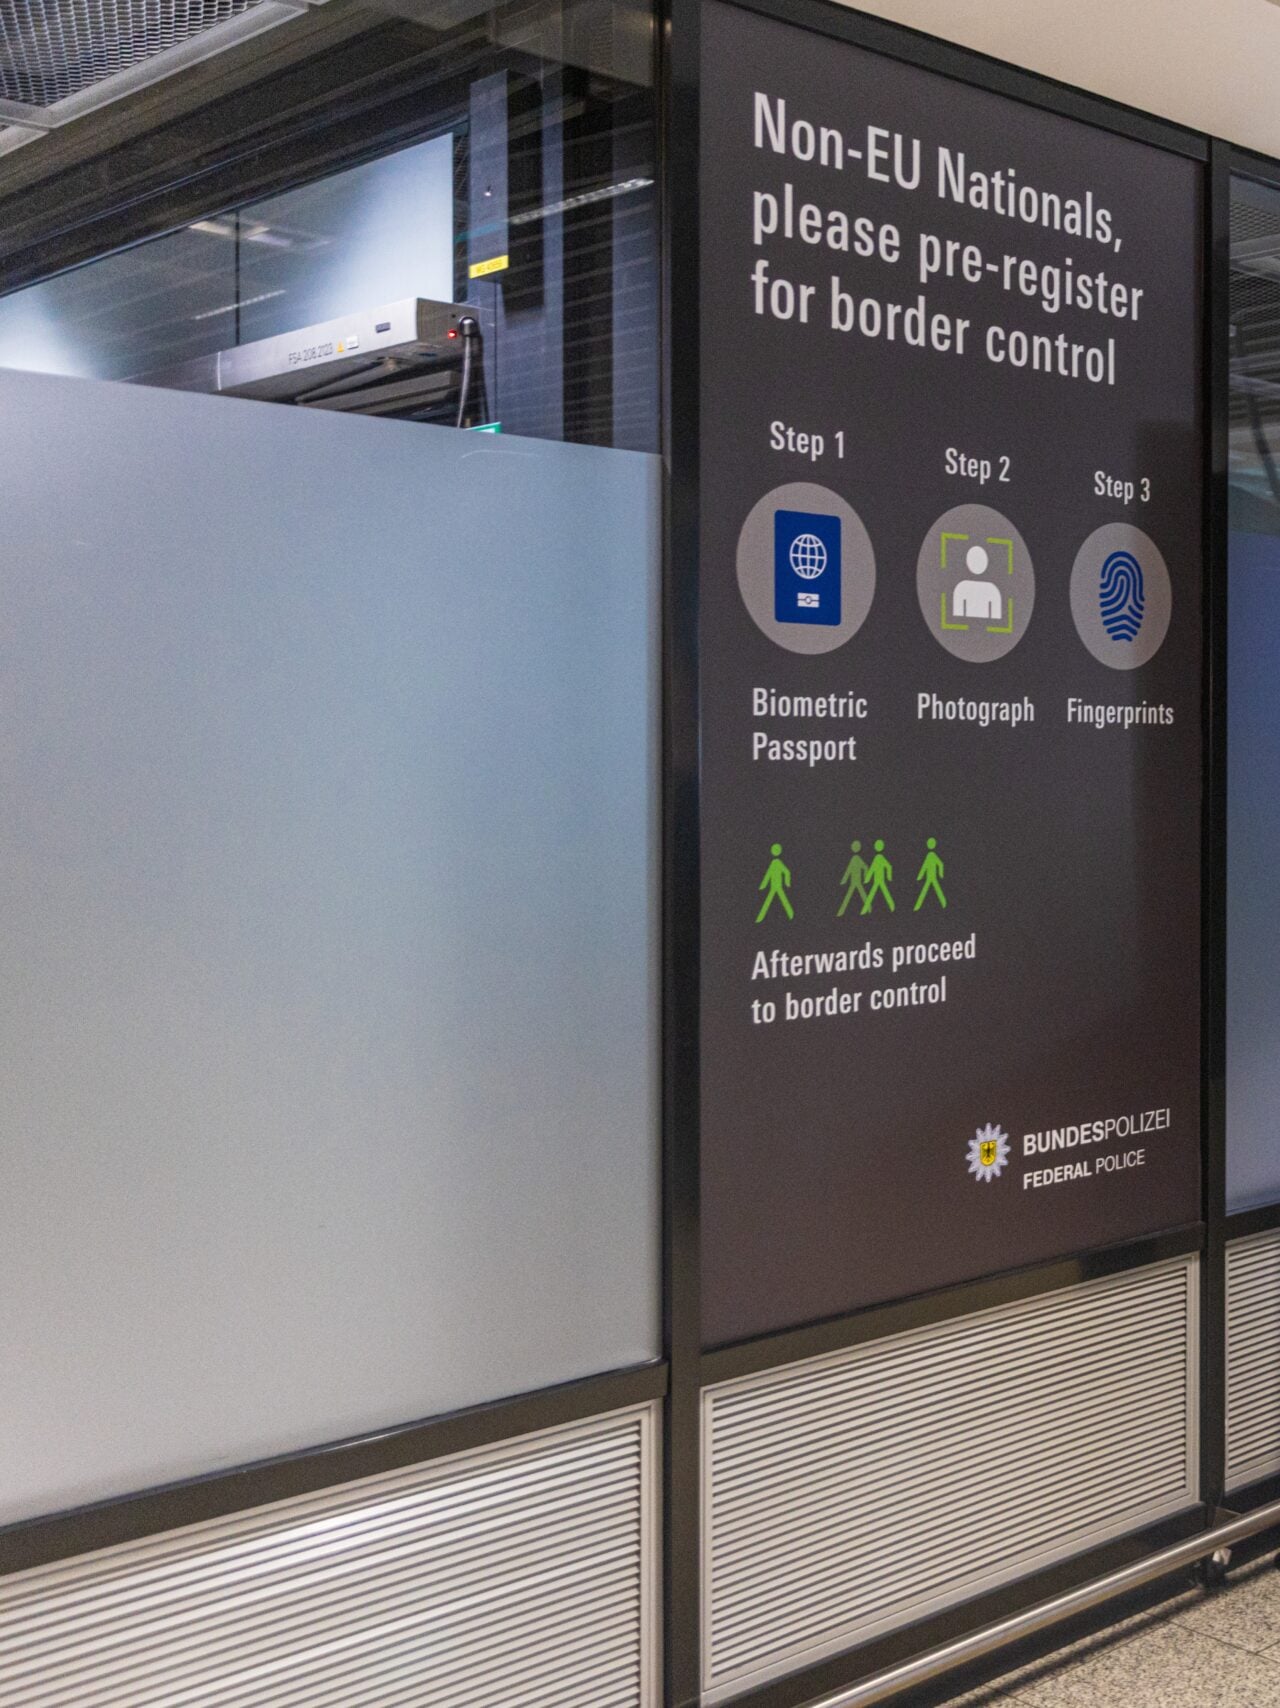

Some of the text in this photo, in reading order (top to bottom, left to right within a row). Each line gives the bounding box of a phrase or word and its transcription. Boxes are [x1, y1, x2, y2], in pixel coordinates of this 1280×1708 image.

[754, 91, 1122, 253] Non-EU Nationals,
[753, 183, 1144, 321] please pre-register
[751, 260, 1116, 386] for border control
[770, 421, 846, 461] Step 1
[944, 447, 1011, 484] Step 2
[1094, 471, 1151, 504] Step 3
[752, 687, 868, 719] Biometric
[916, 693, 1035, 726] Photograph
[1066, 698, 1174, 729] Fingerprints
[752, 732, 857, 767] Passport
[751, 932, 976, 980] Afterwards proceed
[751, 975, 946, 1024] to border control
[1023, 1108, 1170, 1156] BUNDESPOLIZEI
[1023, 1149, 1146, 1190] FEDERAL POLICE
